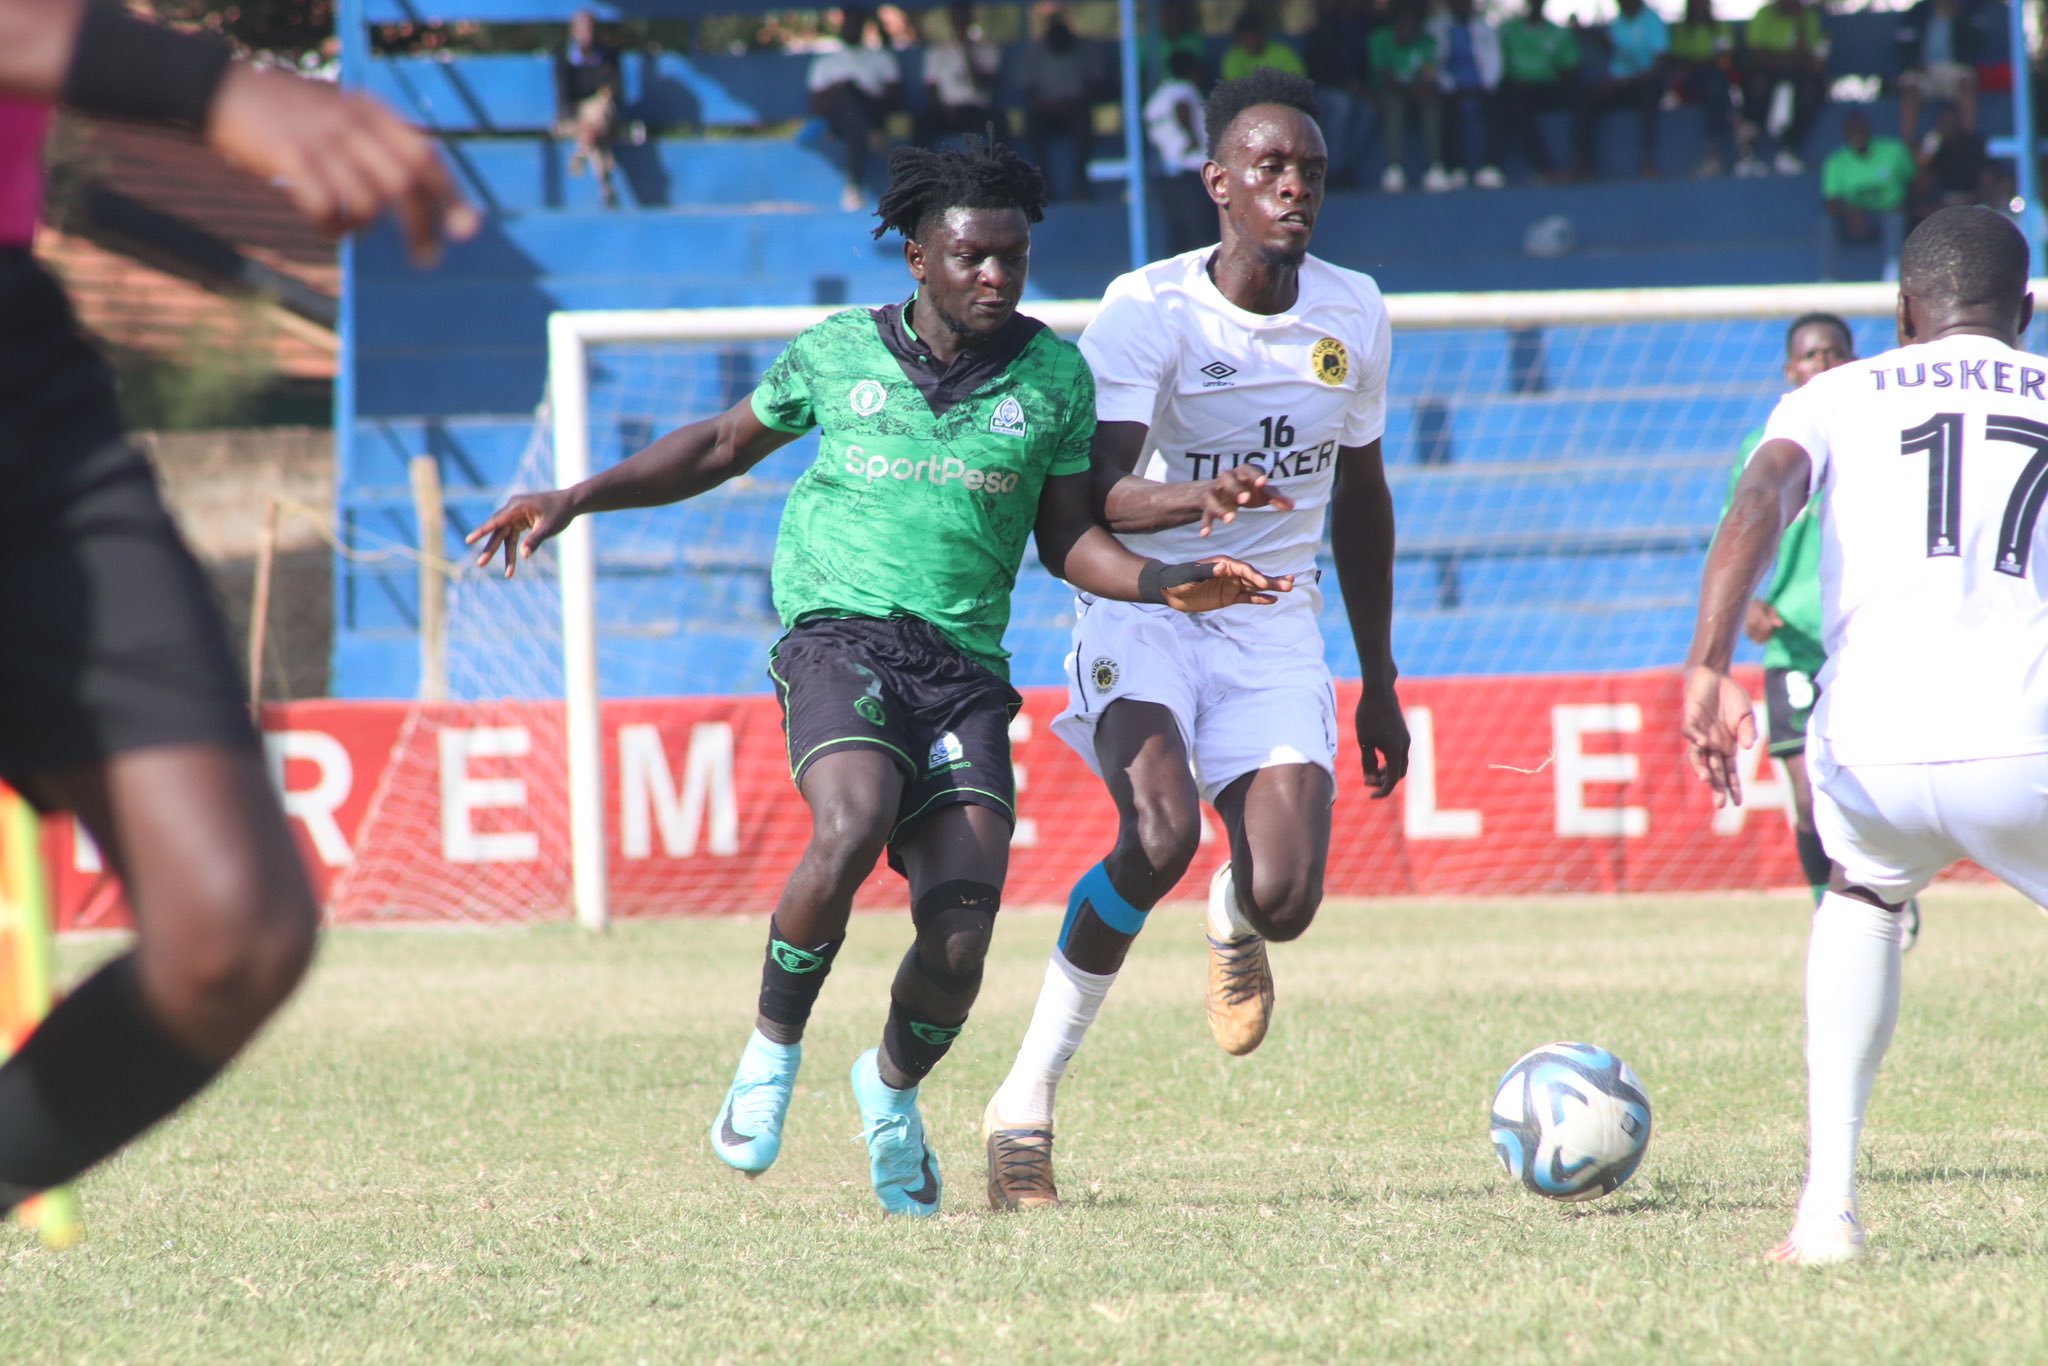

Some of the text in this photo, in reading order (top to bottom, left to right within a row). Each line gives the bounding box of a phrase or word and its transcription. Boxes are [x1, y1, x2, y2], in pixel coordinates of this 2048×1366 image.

[1869, 359, 2047, 401] TUSKER
[1259, 415, 1295, 448] 16
[844, 443, 1020, 494] SportPesa
[1900, 412, 2048, 579] 17
